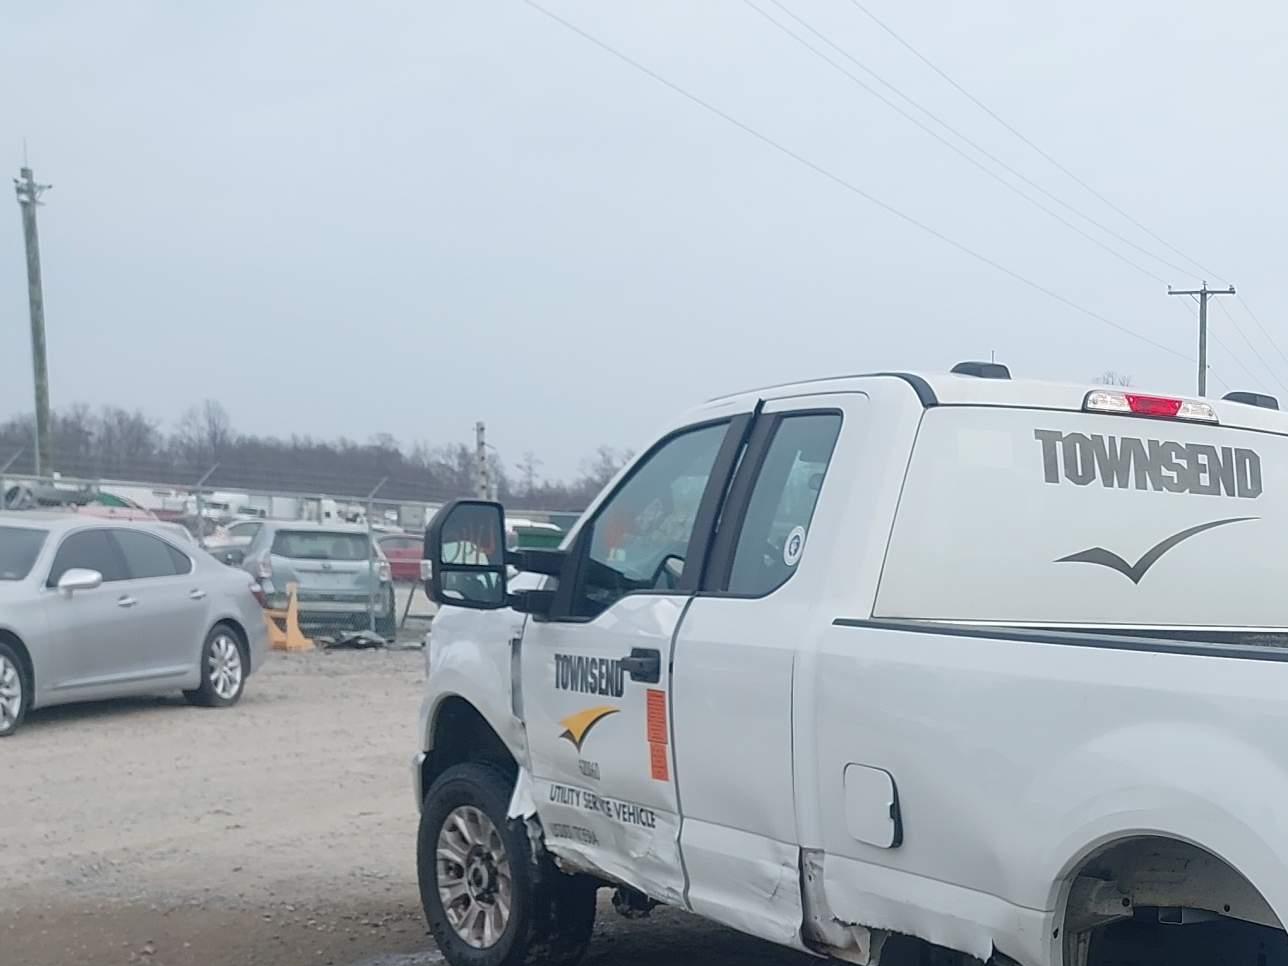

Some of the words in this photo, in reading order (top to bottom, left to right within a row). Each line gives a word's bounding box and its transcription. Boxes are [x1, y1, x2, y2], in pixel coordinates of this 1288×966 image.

[1034, 429, 1263, 499] TOWNSEND
[554, 653, 624, 698] TOWNSEND
[549, 784, 580, 807] UTILITY
[613, 801, 656, 829] VEHICLE
